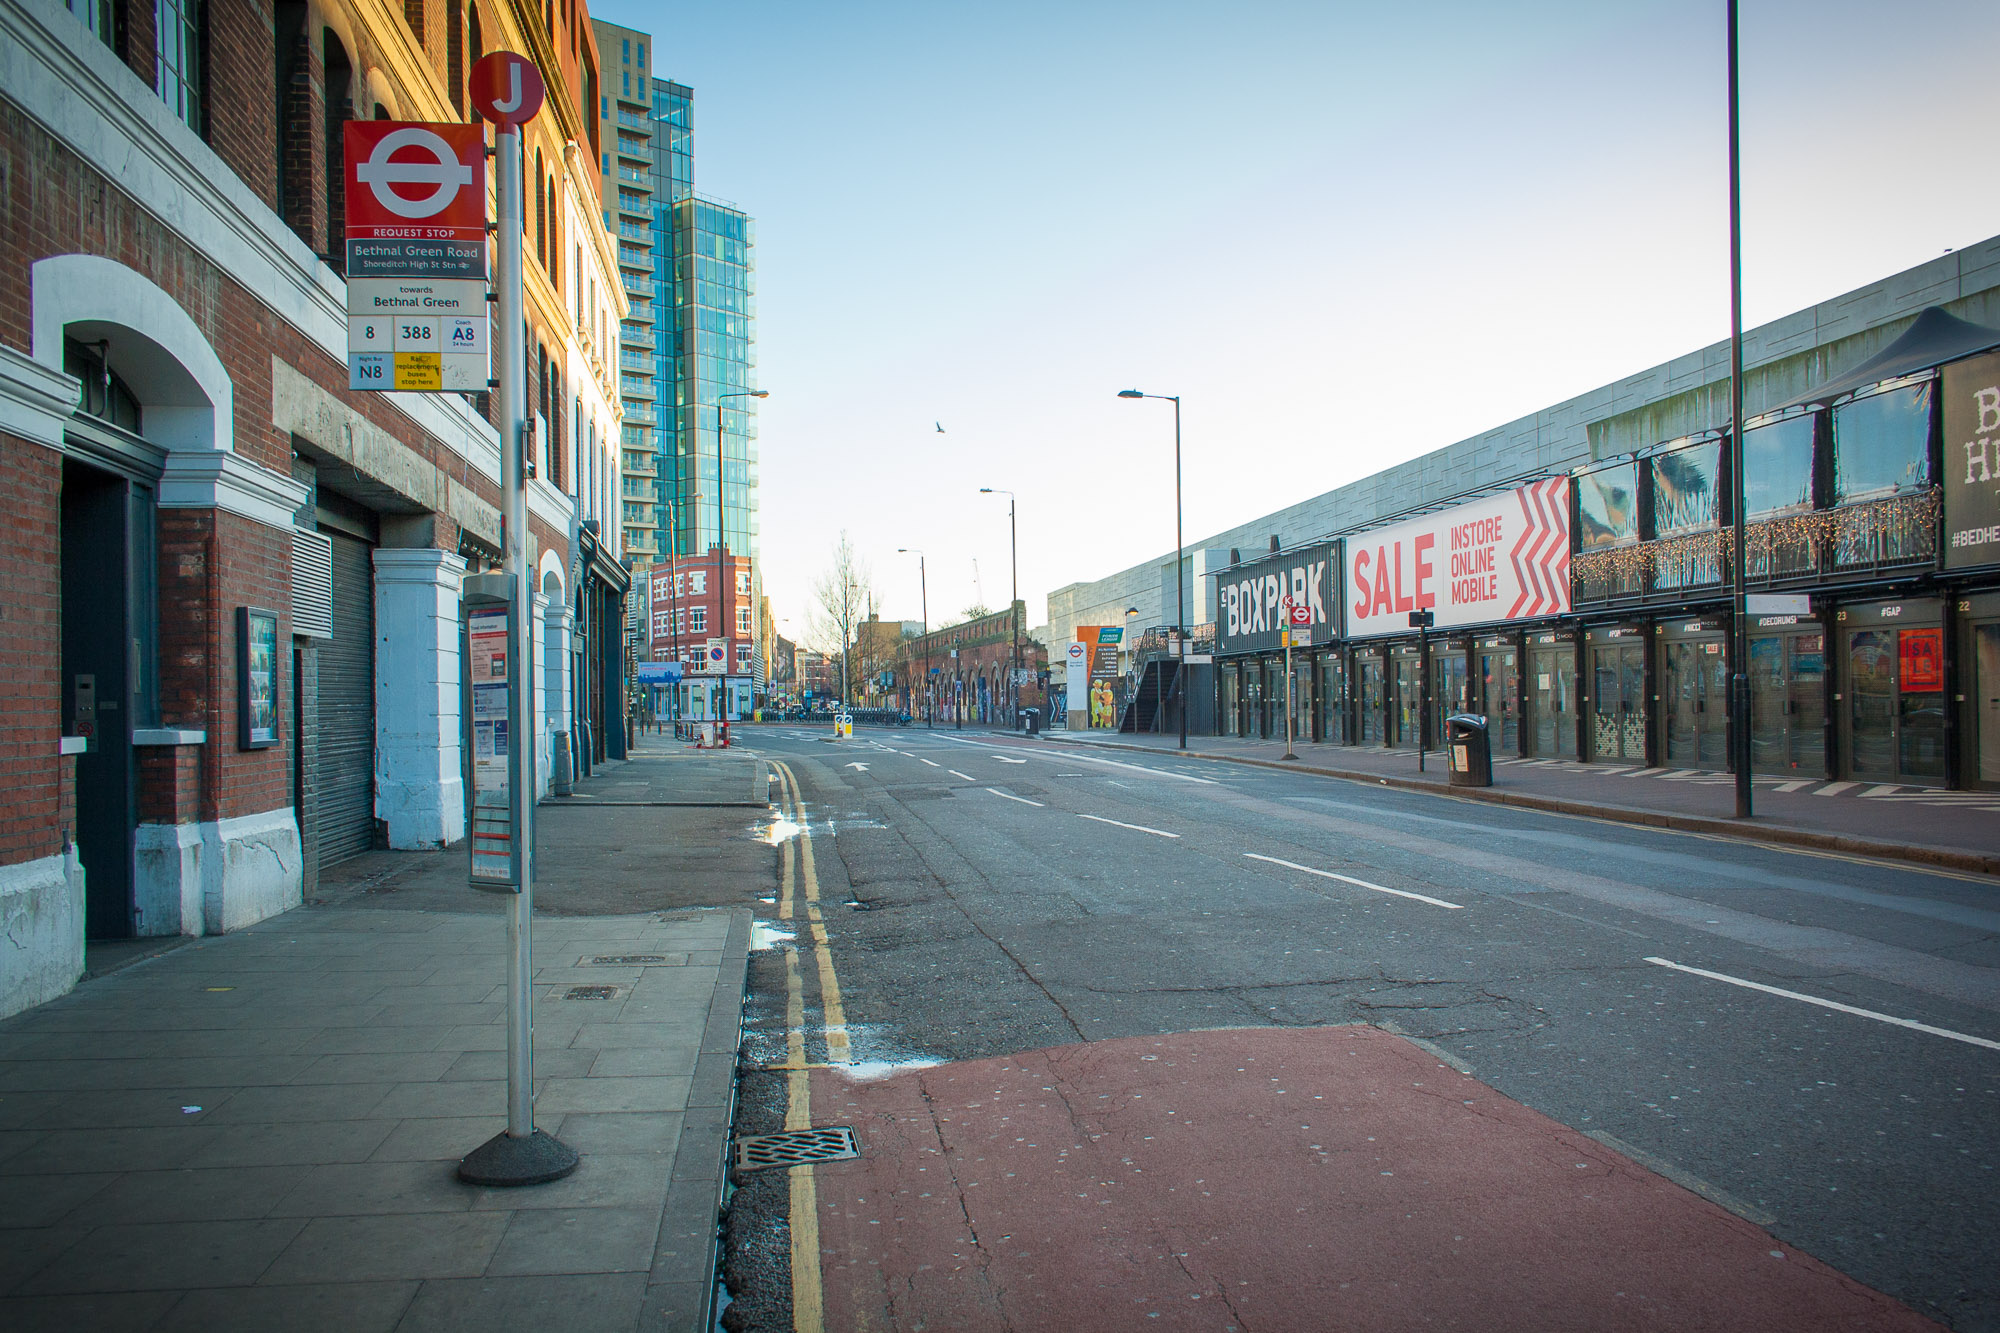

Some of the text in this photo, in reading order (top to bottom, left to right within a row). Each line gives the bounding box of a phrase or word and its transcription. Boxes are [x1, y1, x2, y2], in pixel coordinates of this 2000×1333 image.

[492, 62, 522, 113] J
[373, 228, 455, 238] REQUEST STOP
[355, 245, 478, 258] Bethnal Green Road
[363, 260, 457, 270] Shoreditch High St Stn
[399, 286, 433, 294] towards
[374, 296, 460, 308] Bethnal Green
[365, 325, 375, 339] 8
[401, 325, 432, 340] 388
[452, 327, 475, 341] A8
[359, 365, 383, 379] N8
[1451, 515, 1502, 551] INSTORE
[1451, 546, 1495, 578] ONLINE
[1354, 532, 1435, 620] SALE
[1451, 574, 1497, 605] MOBILE
[1227, 560, 1326, 637] BOXPARK
[1284, 596, 1292, 605] K
[1880, 606, 1901, 617] #GAP
[1958, 601, 1970, 612] 22
[1836, 611, 1847, 621] 23
